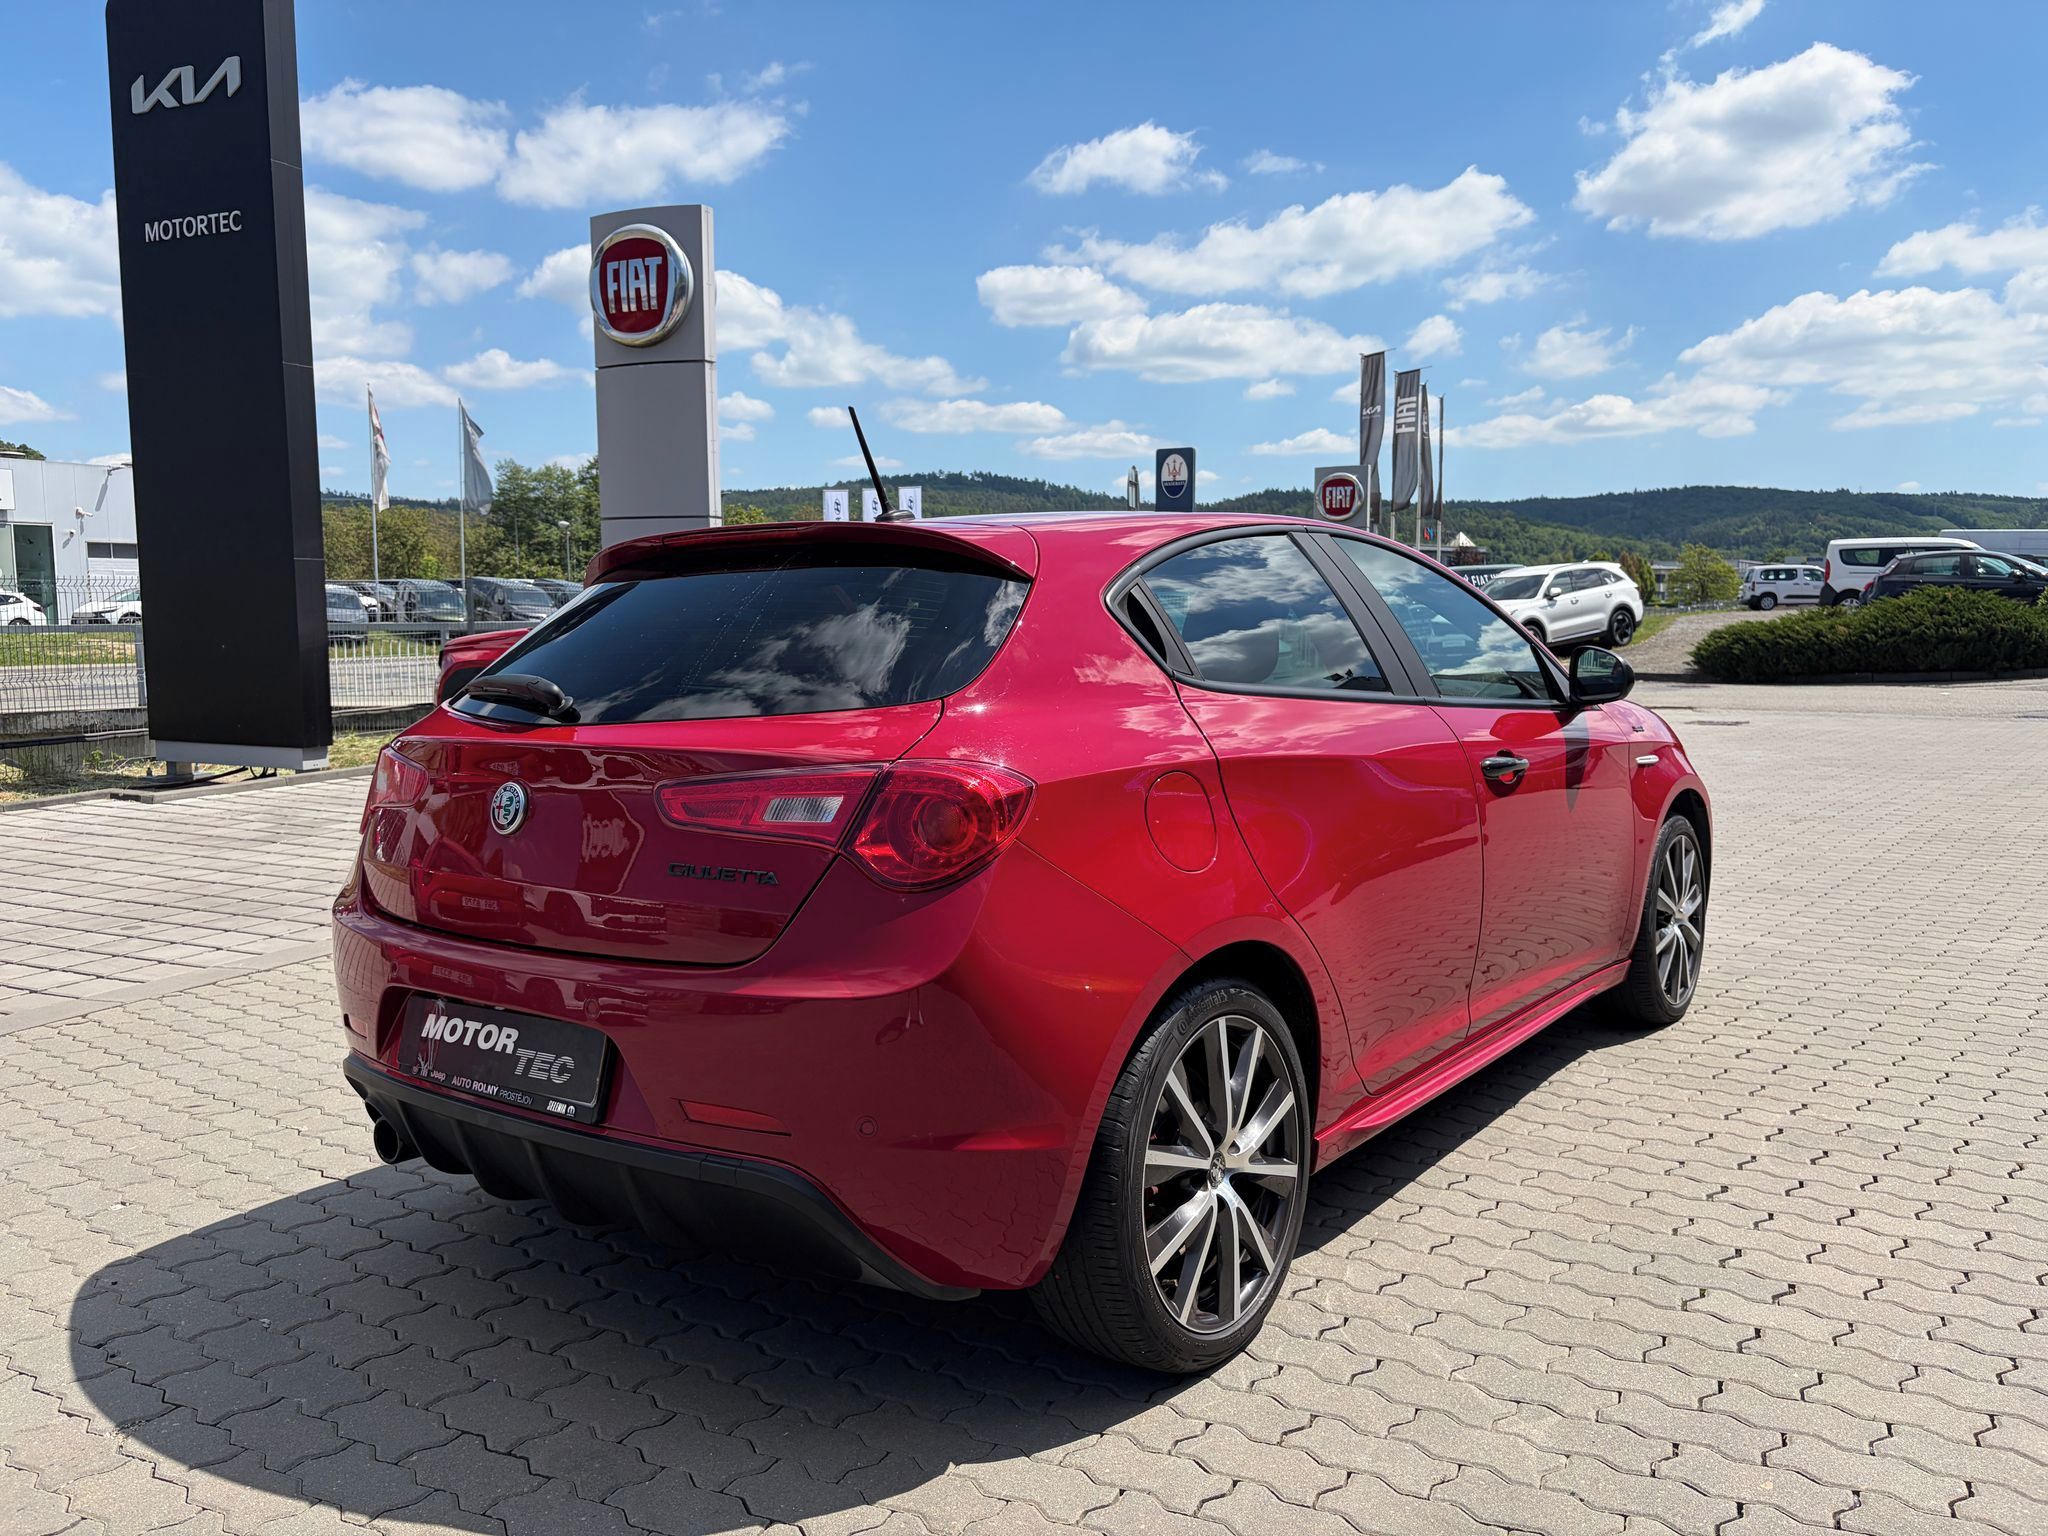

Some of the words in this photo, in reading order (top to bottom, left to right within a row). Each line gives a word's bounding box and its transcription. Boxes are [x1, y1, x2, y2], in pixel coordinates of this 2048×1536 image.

[131, 56, 241, 114] KIA
[145, 211, 242, 242] MOTORTEC
[606, 256, 662, 314] FIAT
[1395, 396, 1417, 433] FIAT
[1326, 486, 1353, 508] FIAT
[1471, 574, 1489, 586] FIAT
[668, 862, 779, 885] GIULIETTA
[421, 1013, 519, 1054] MOTOR
[430, 1070, 447, 1082] Jeep
[451, 1075, 472, 1089] AUTO
[514, 1048, 575, 1084] TEC
